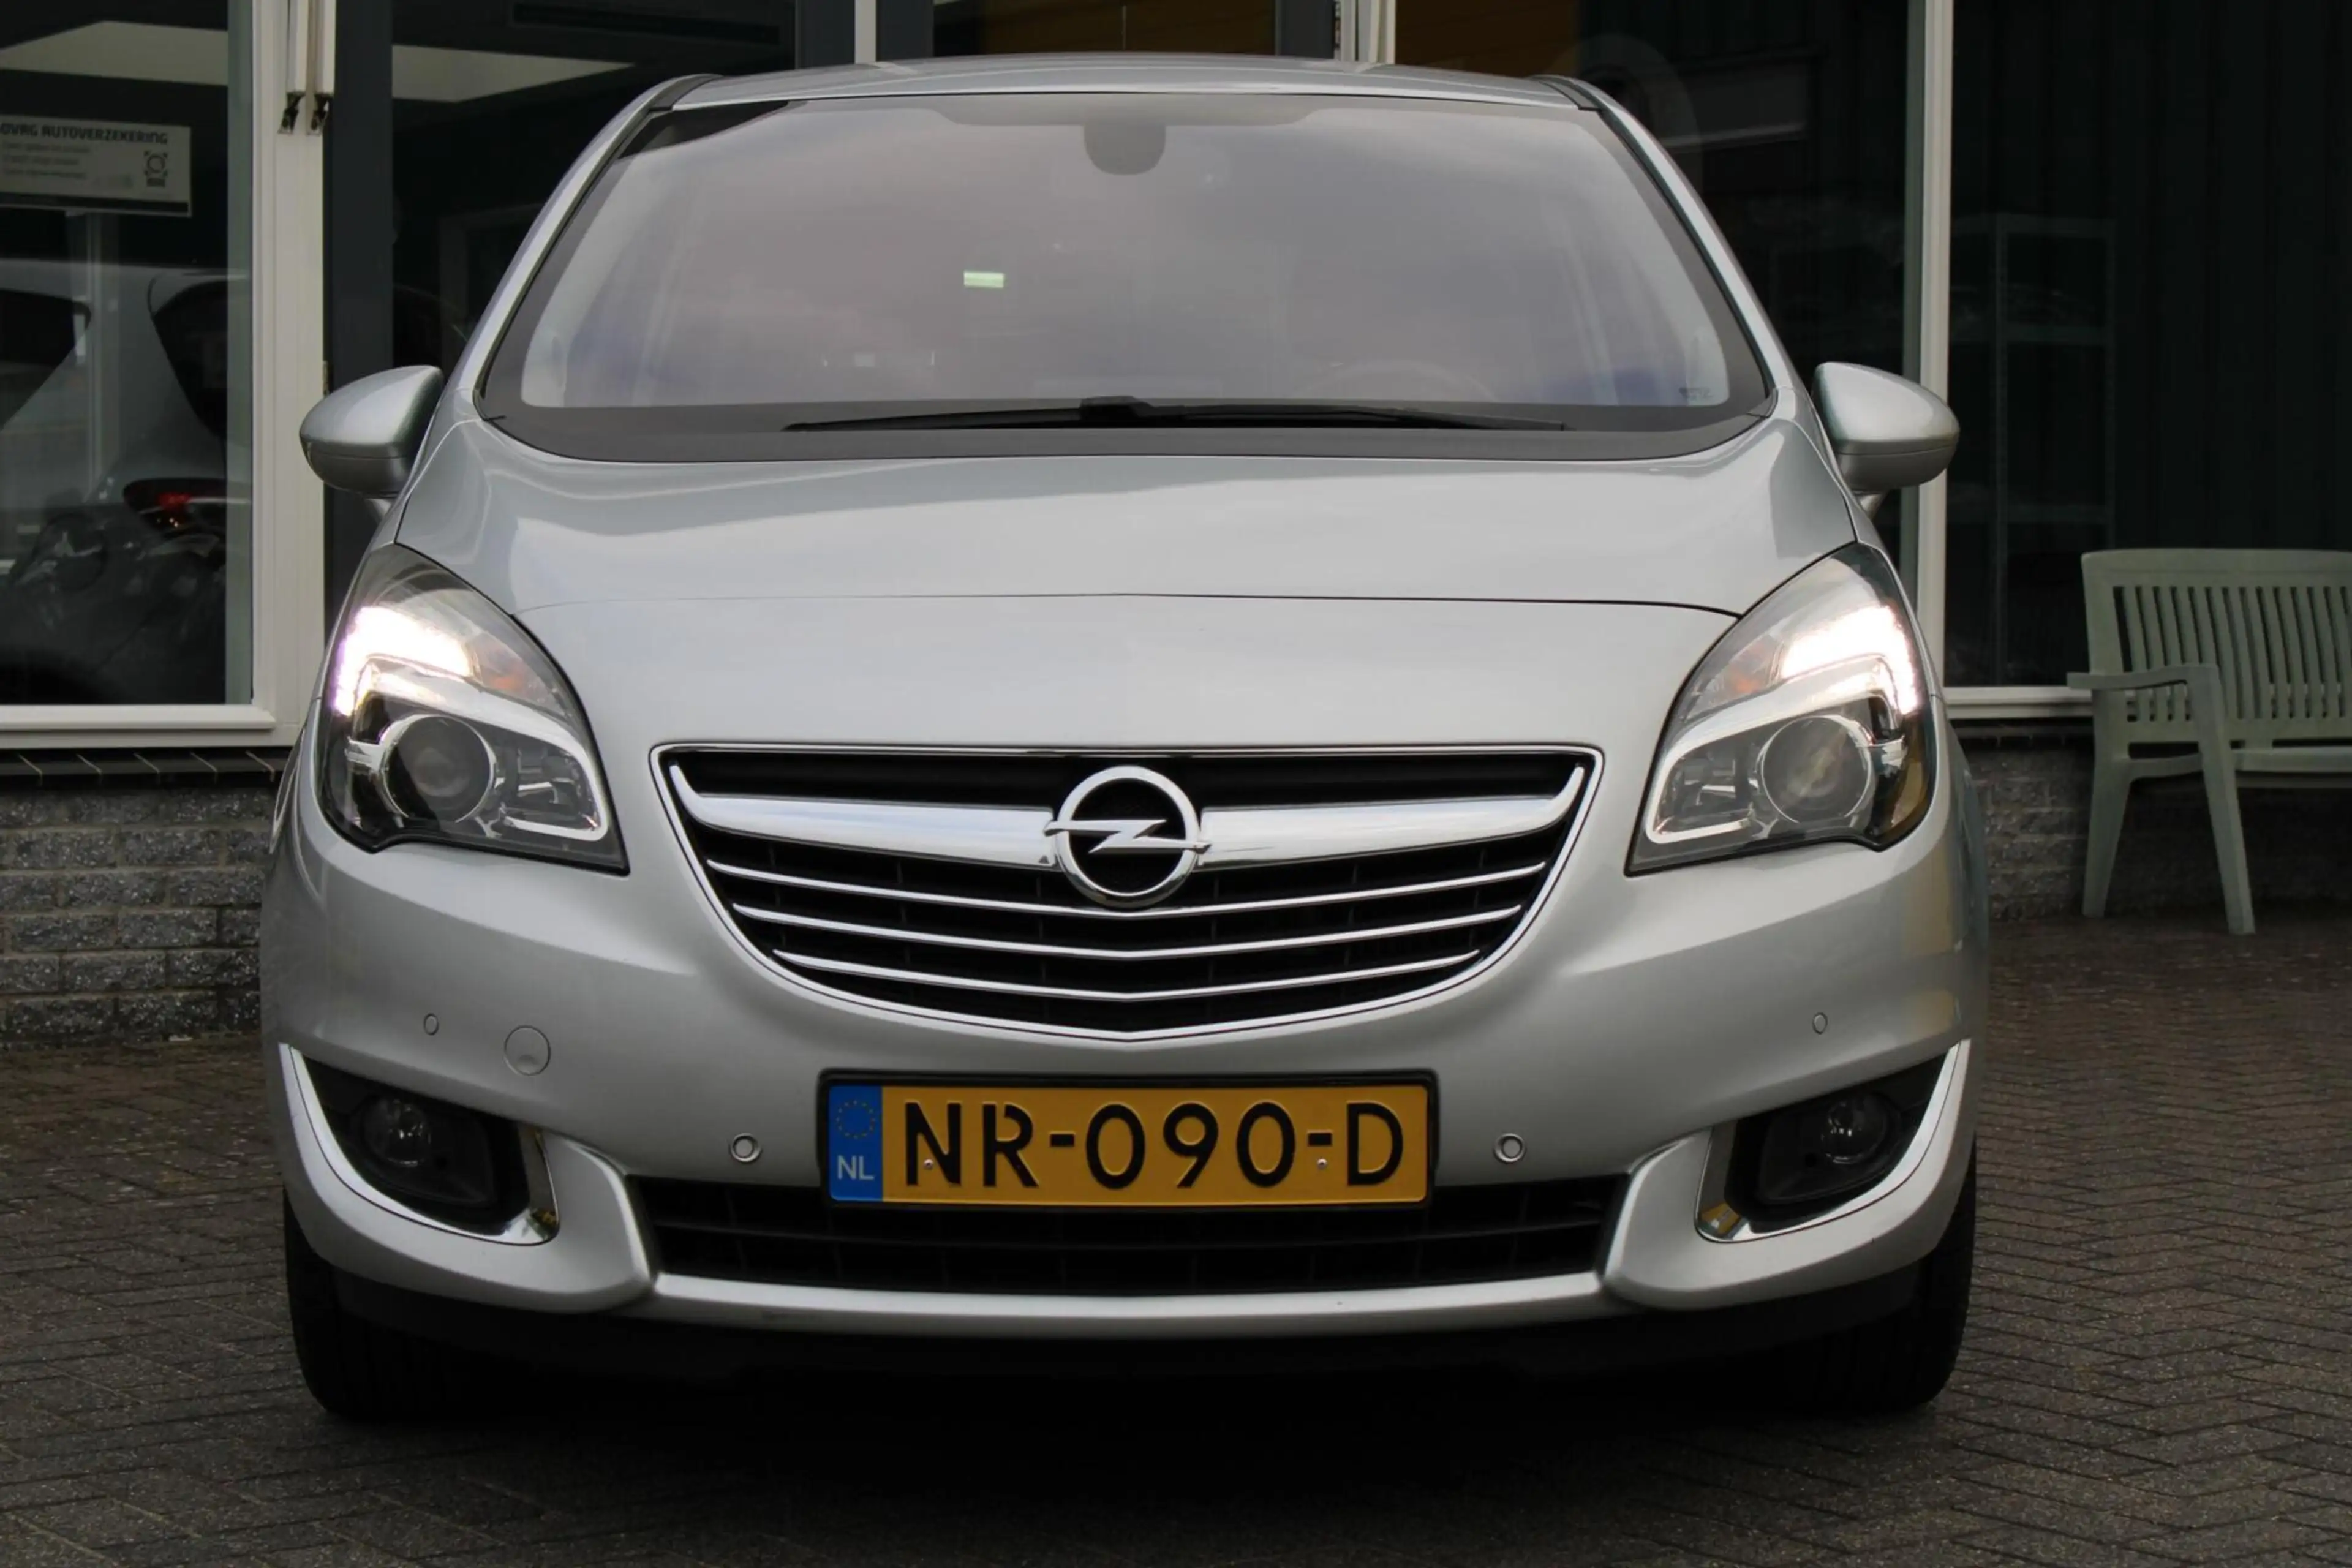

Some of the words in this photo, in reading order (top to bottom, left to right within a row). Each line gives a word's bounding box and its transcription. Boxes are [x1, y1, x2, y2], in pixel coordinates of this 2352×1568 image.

[41, 125, 167, 145] AUTOVERZEKERING
[905, 1102, 1403, 1189] NR-090-D
[837, 1155, 875, 1180] NL
